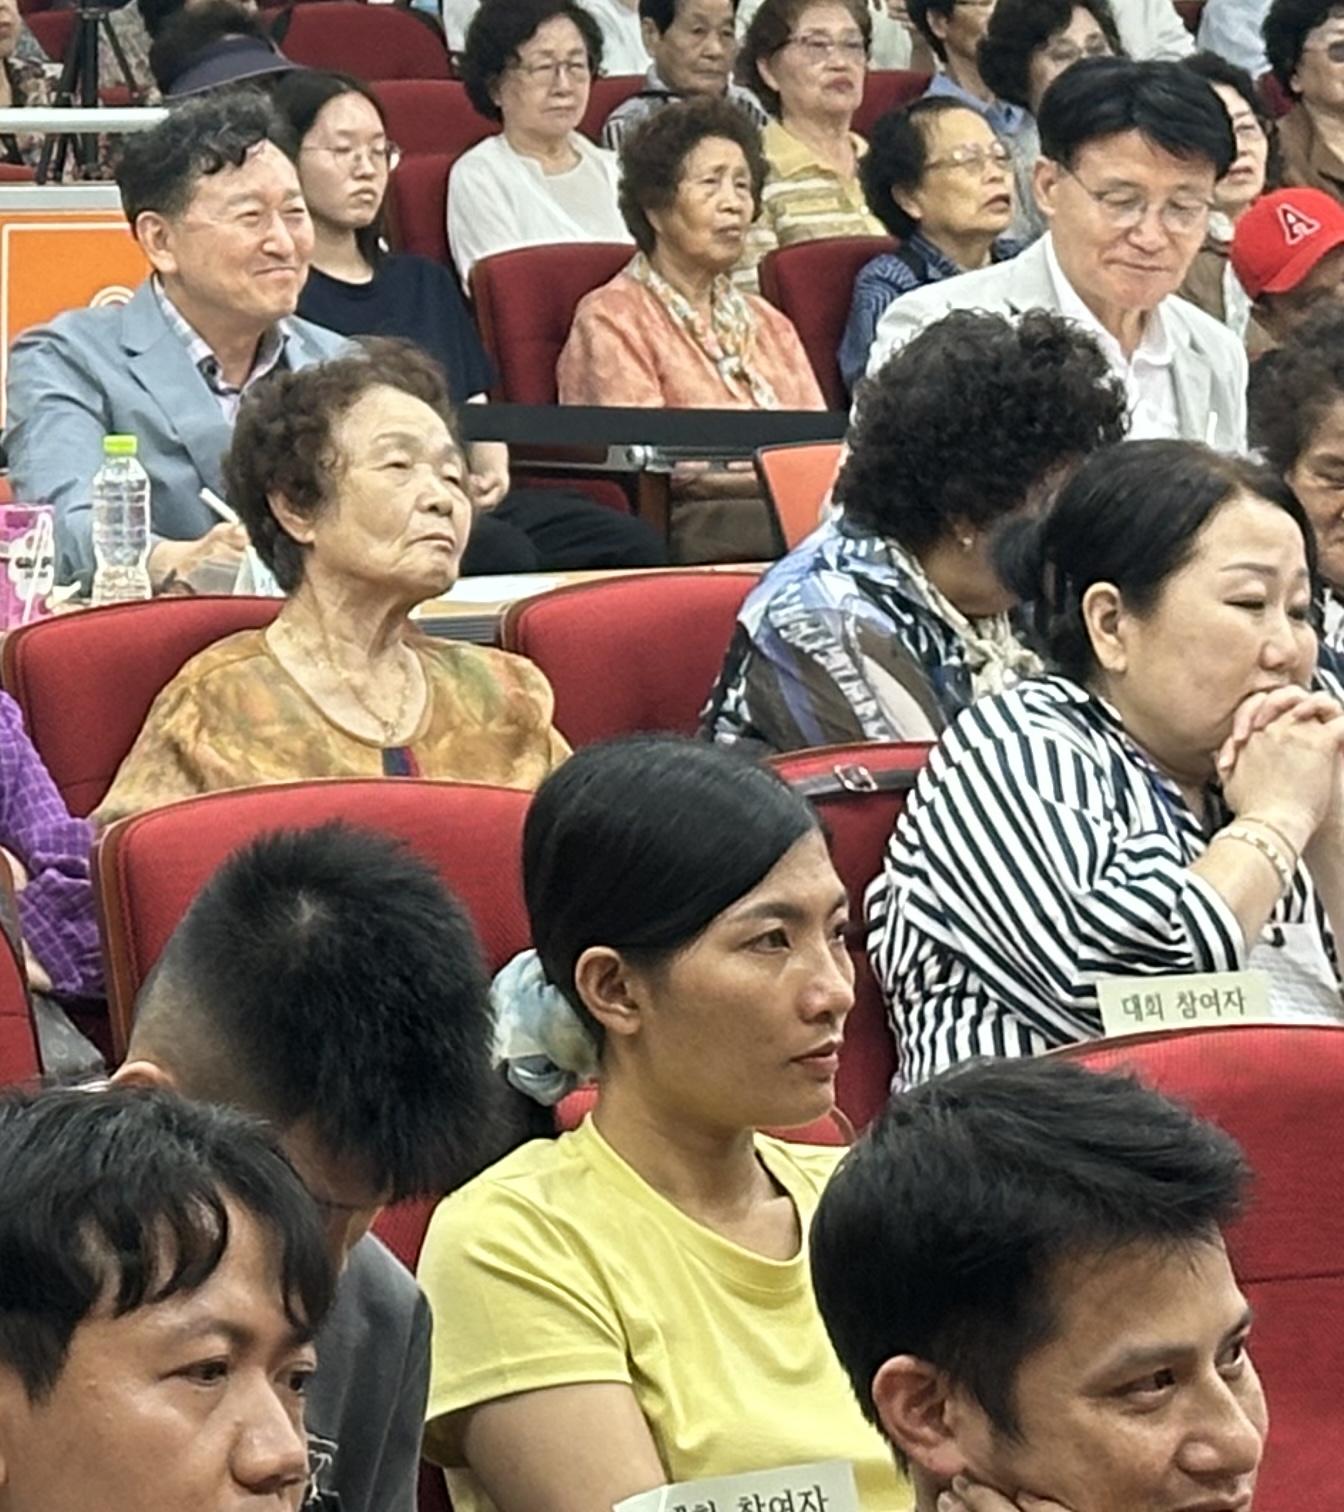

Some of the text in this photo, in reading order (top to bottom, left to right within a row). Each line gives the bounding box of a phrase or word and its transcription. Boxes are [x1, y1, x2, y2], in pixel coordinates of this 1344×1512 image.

[1276, 202, 1321, 245] A
[1121, 986, 1245, 1022] 대회 참여자
